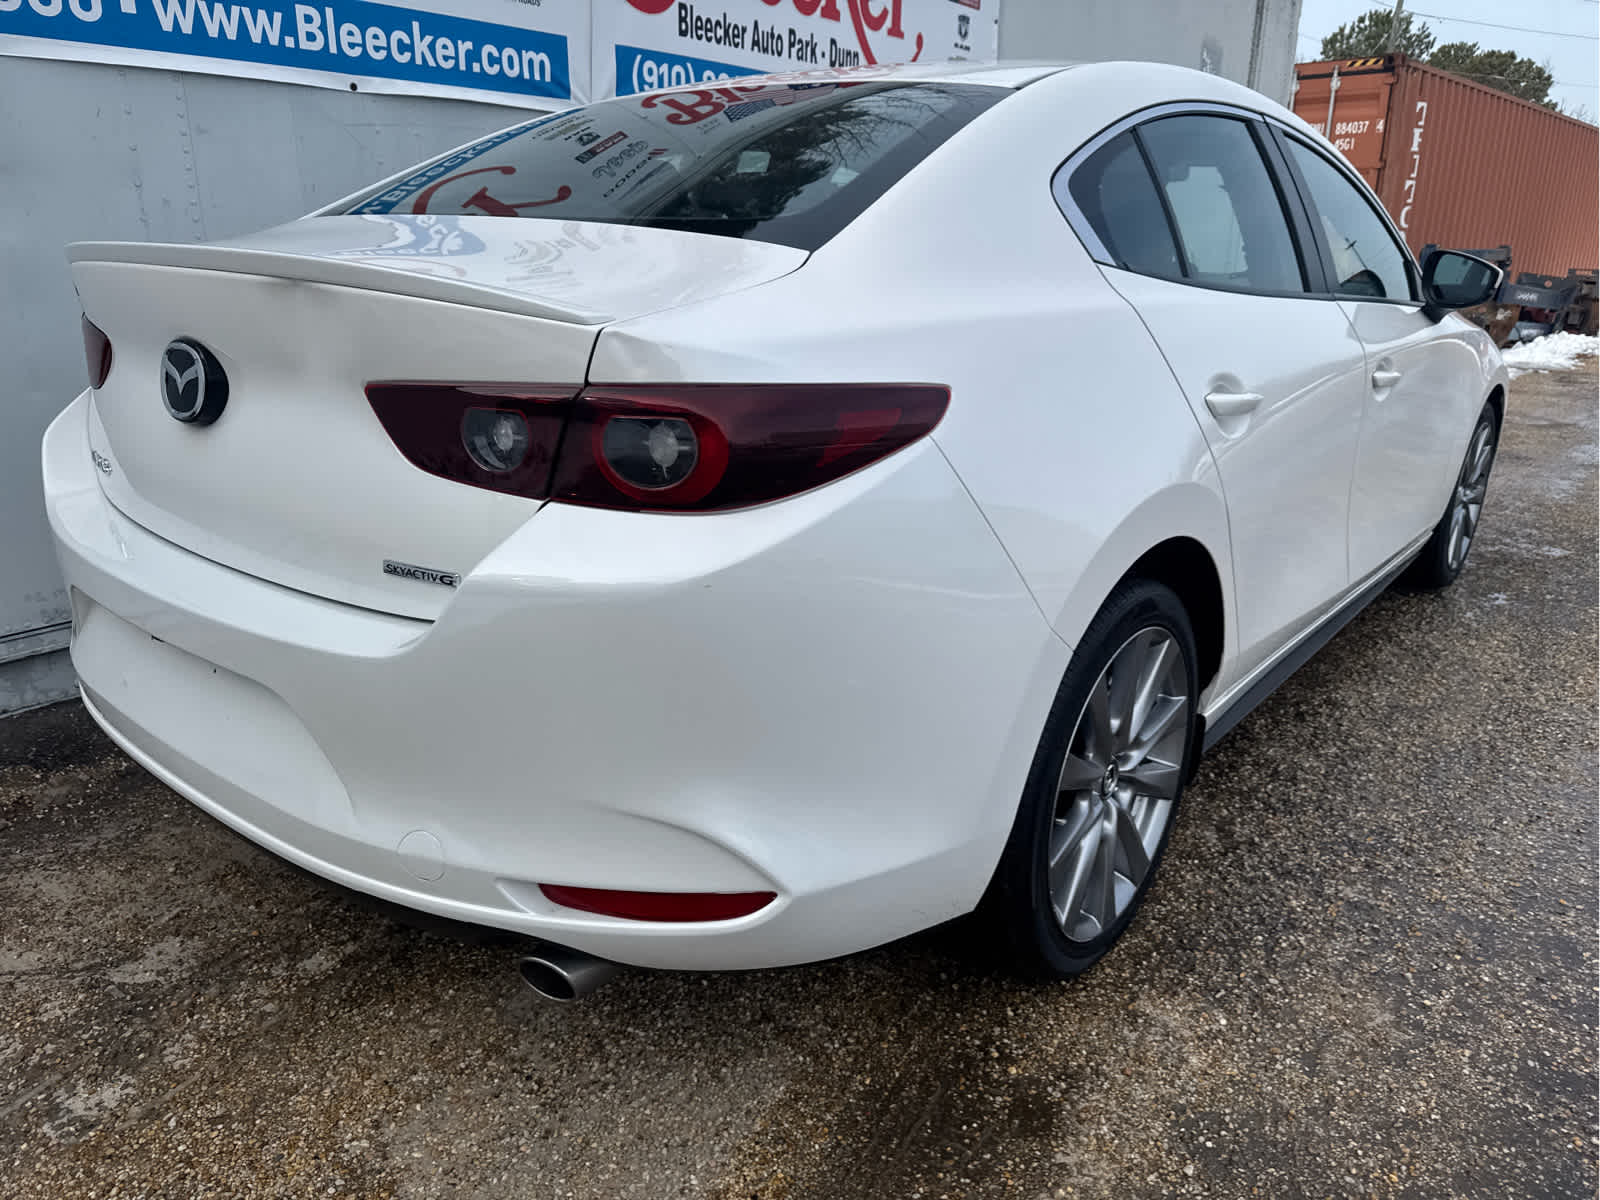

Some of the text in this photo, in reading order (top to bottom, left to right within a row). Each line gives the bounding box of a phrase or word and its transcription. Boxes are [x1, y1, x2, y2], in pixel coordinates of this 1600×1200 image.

[150, 0, 552, 83] www.Bleecker.com
[678, 2, 747, 50] Bleecker
[751, 20, 784, 57] Auto
[788, 28, 818, 65] Park
[829, 38, 860, 68] Dunn
[1335, 120, 1370, 135] 884037
